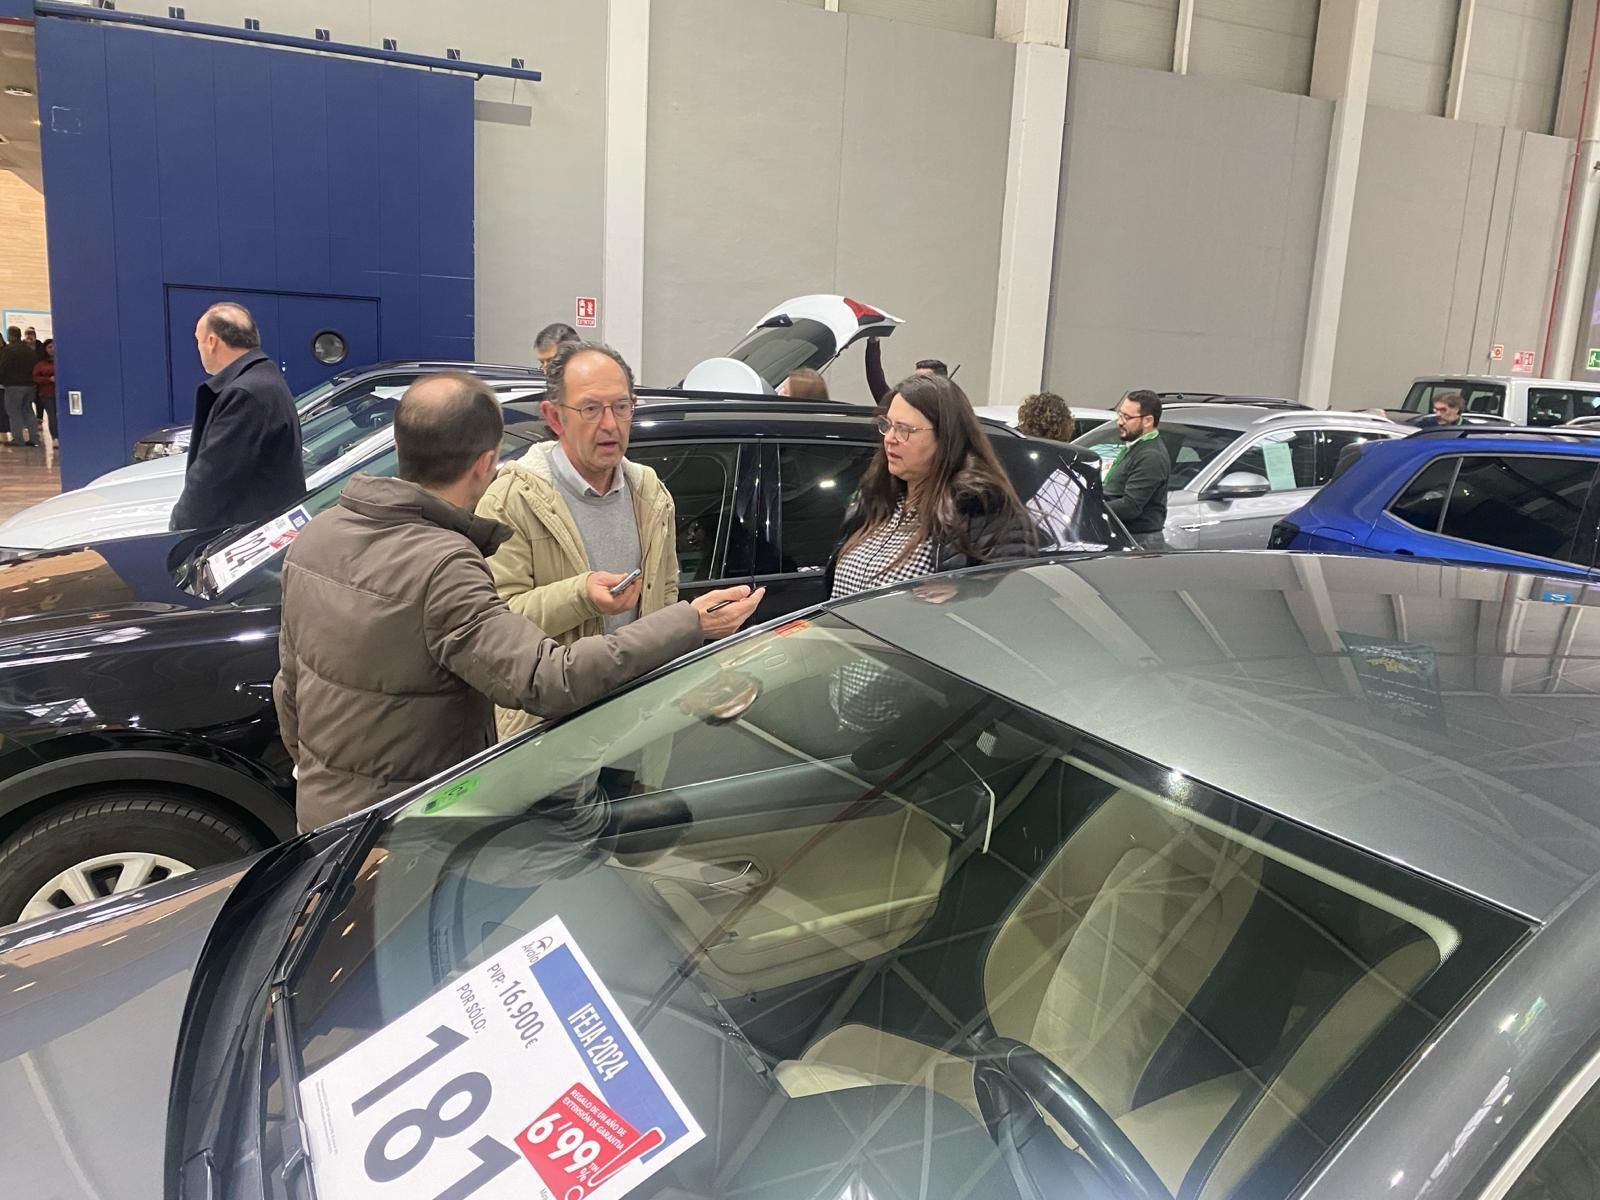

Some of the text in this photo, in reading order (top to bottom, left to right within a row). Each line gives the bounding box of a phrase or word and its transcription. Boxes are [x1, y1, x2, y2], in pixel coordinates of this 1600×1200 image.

[486, 963, 506, 988] PVP:
[456, 983, 487, 1034] POR SÓLO:
[567, 1002, 629, 1082] IFEJA 2024
[562, 1097, 592, 1123] EXTENSIÓN
[589, 1119, 599, 1130] DE
[570, 1089, 628, 1137] REGALO DE UN AÑO DE
